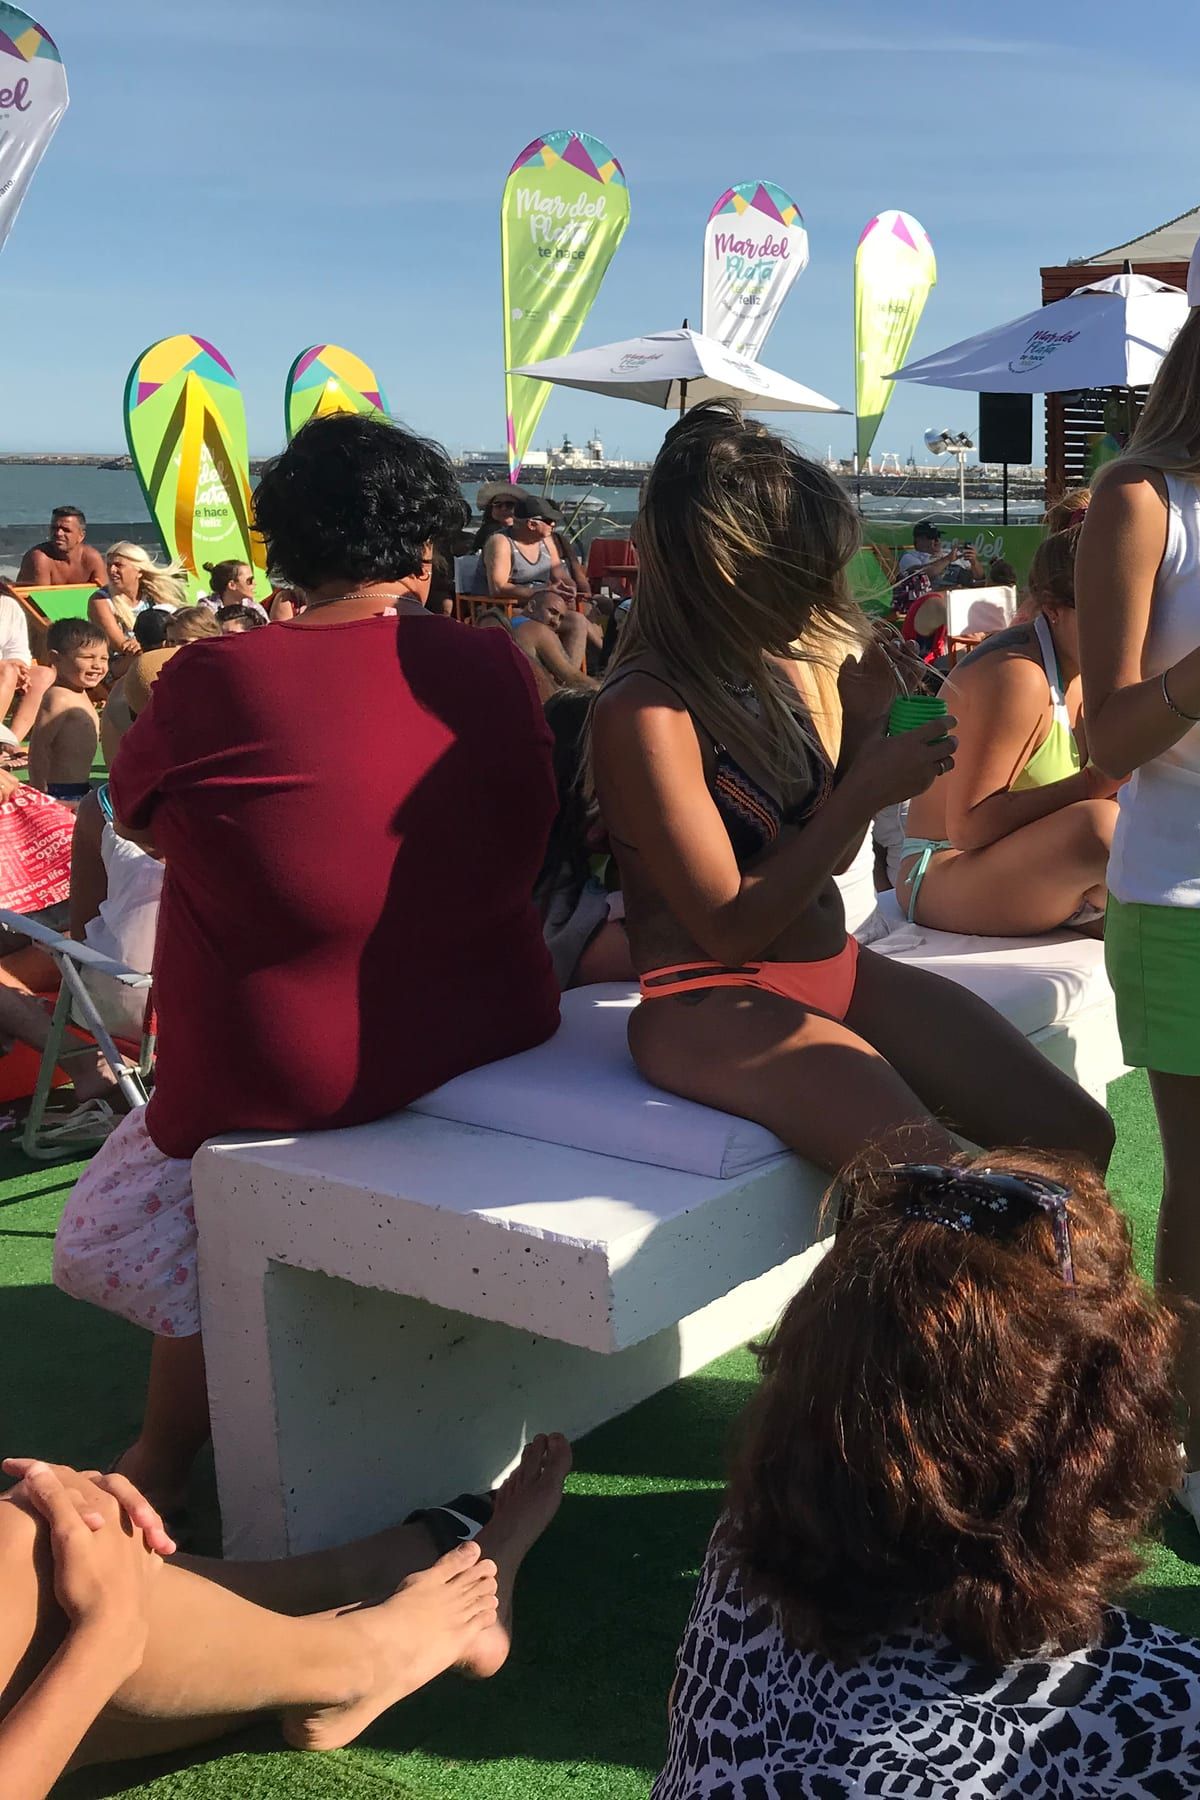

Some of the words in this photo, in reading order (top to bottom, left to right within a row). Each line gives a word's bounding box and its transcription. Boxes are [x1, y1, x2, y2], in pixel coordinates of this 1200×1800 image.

[0, 77, 32, 112] el
[517, 188, 569, 219] Mar
[568, 192, 607, 221] del
[538, 246, 551, 258] te
[715, 233, 759, 260] Mar
[758, 234, 790, 259] del
[726, 255, 778, 284] Plata
[739, 294, 761, 305] feliz
[204, 507, 229, 518] hace
